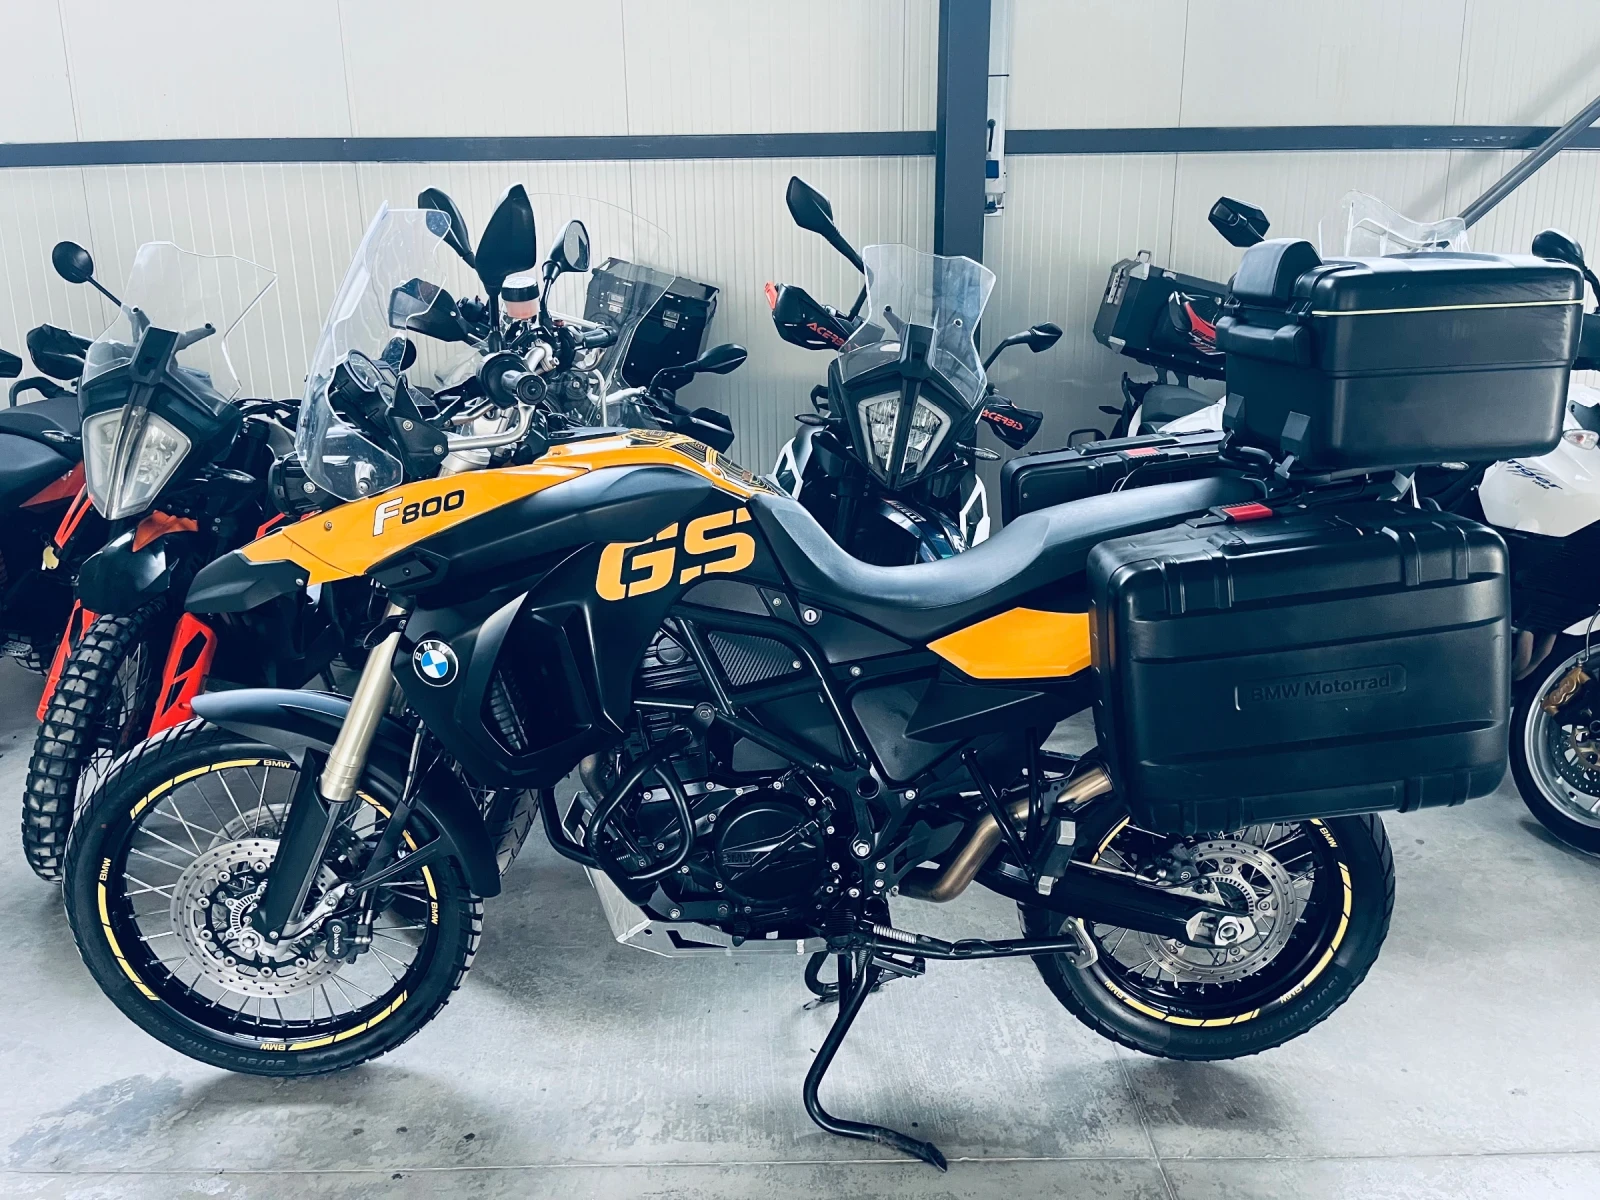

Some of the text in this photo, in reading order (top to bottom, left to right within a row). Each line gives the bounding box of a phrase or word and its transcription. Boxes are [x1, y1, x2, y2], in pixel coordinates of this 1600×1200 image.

[595, 507, 756, 601] GS
[415, 642, 449, 661] BMW
[1251, 672, 1391, 701] BMW Motorrad
[263, 759, 291, 769] BMW
[1319, 827, 1338, 848] BMW
[99, 857, 112, 882] BMW
[430, 901, 439, 925] BMW
[1104, 980, 1124, 999] BMW
[1280, 985, 1303, 1004] BMW
[259, 1043, 286, 1052] BMW
